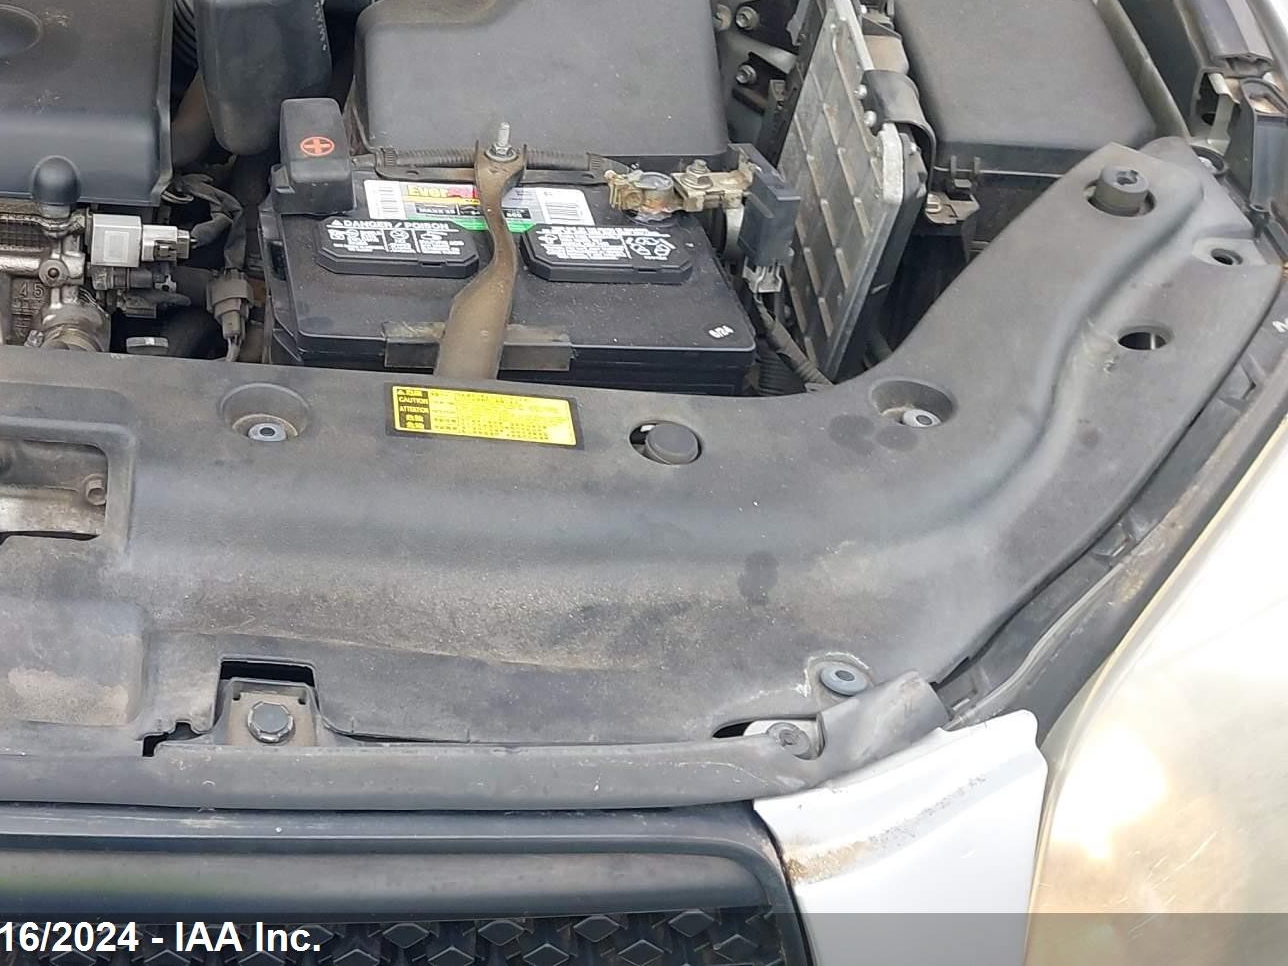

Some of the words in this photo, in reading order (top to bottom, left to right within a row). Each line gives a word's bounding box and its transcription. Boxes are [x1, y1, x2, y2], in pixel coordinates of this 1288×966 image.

[342, 219, 394, 229] DANGER
[404, 222, 450, 231] POISON
[398, 396, 429, 405] CAUTION
